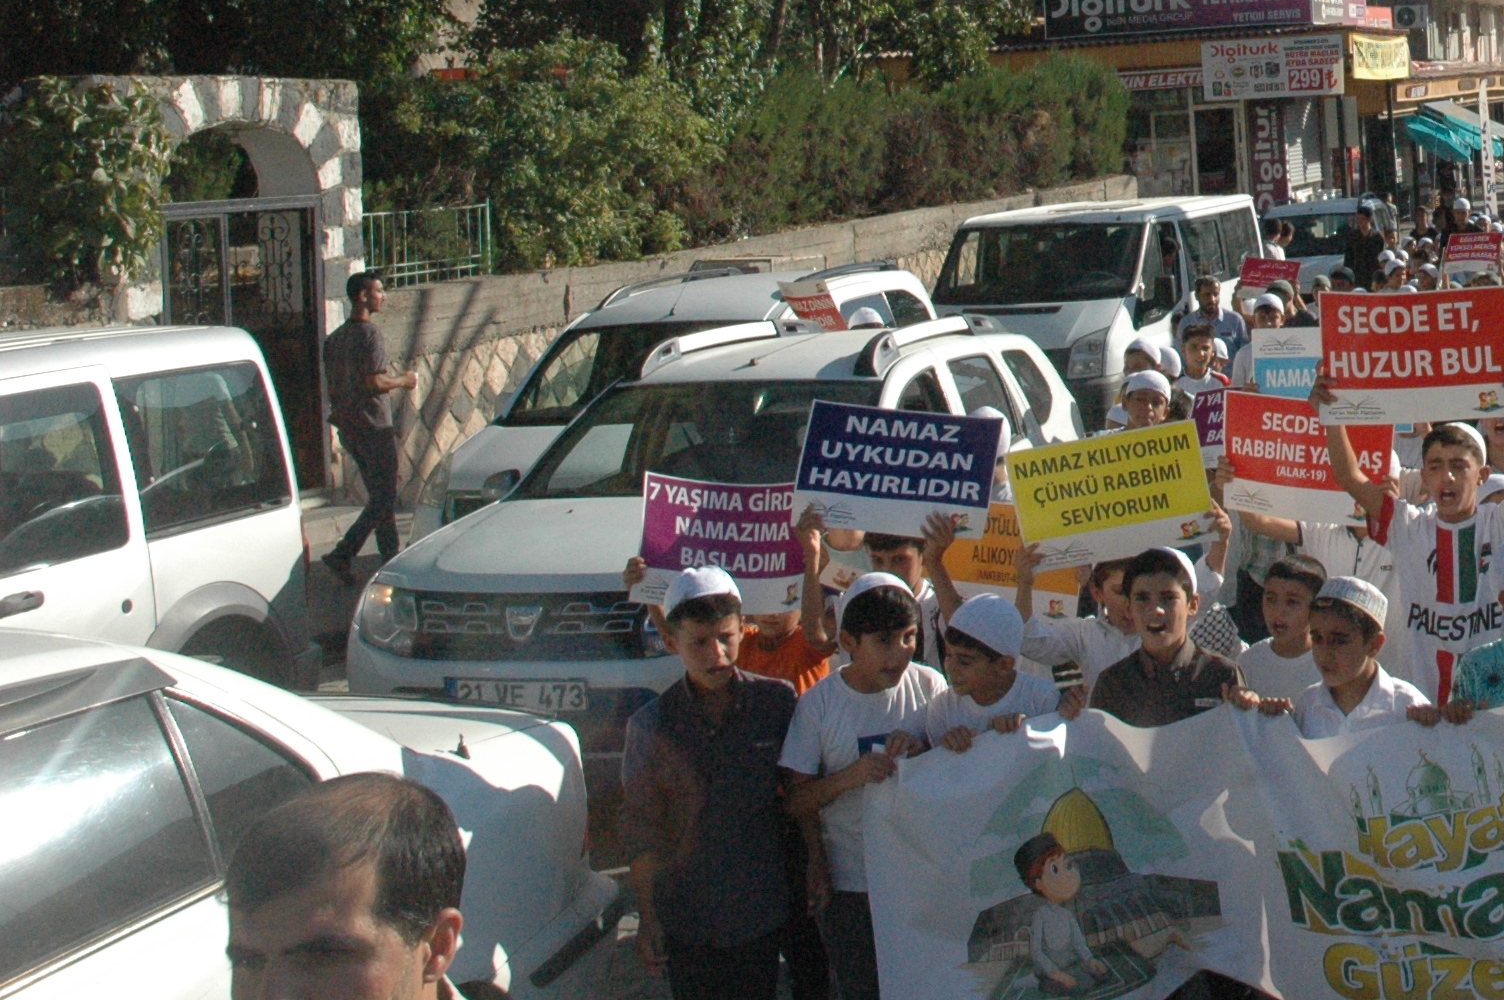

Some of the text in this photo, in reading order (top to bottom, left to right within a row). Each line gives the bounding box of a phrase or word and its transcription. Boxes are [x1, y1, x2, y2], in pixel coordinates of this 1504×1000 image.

[1210, 42, 1279, 64] Digiturk
[1289, 69, 1321, 90] 299
[1337, 301, 1479, 334] SECDE ET,
[1329, 346, 1502, 379] HUZUR BUL
[846, 415, 961, 443] NAMAZ
[1262, 412, 1319, 436] SECDE
[821, 440, 974, 471] UYKUDAN
[1014, 433, 1190, 481] NAMAZ KILIYORUM
[1232, 436, 1305, 463] RABBİNE
[808, 466, 980, 501] HAYIRLIDIR
[1033, 459, 1182, 508] ÇÜNKÜ RABBİMİ
[1276, 465, 1326, 482] (ALAK-19)
[649, 481, 794, 512] 7 YAŞIMA GİRD
[1060, 493, 1170, 527] SEVİYORUM
[675, 515, 790, 542] NAMAZIMA
[972, 545, 1015, 566] ALIKOY
[1407, 602, 1502, 641] PALESTINE
[458, 684, 584, 710] 21 VE 473
